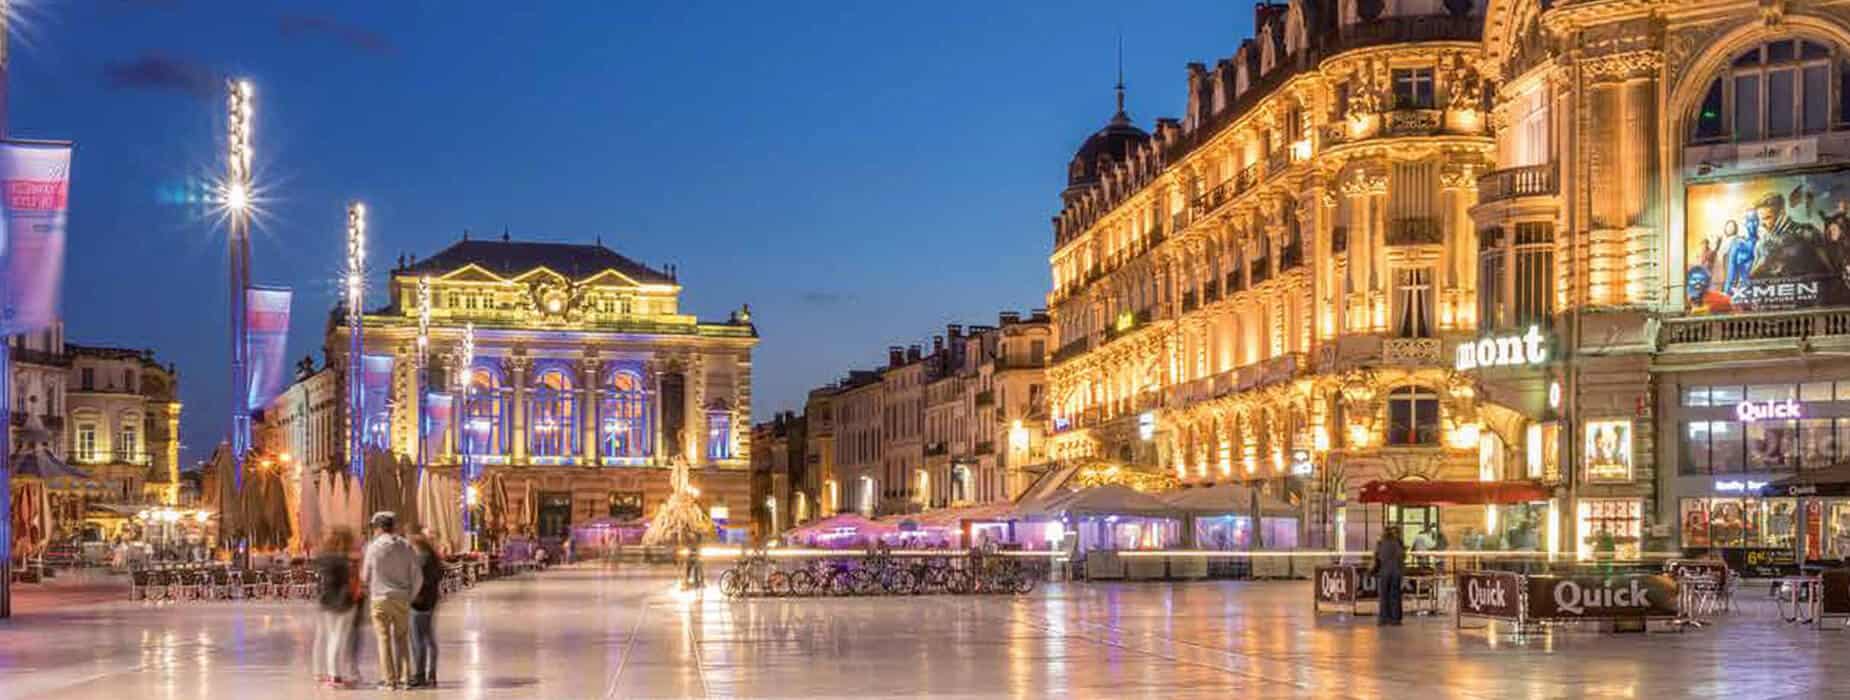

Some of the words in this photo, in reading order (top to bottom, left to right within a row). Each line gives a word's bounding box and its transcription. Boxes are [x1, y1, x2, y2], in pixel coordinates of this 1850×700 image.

[1733, 281, 1819, 298] X-MEN
[1737, 397, 1801, 421] Quick
[1321, 571, 1346, 598] Quick
[1468, 578, 1506, 611] Quick
[1554, 579, 1650, 615] Quick
